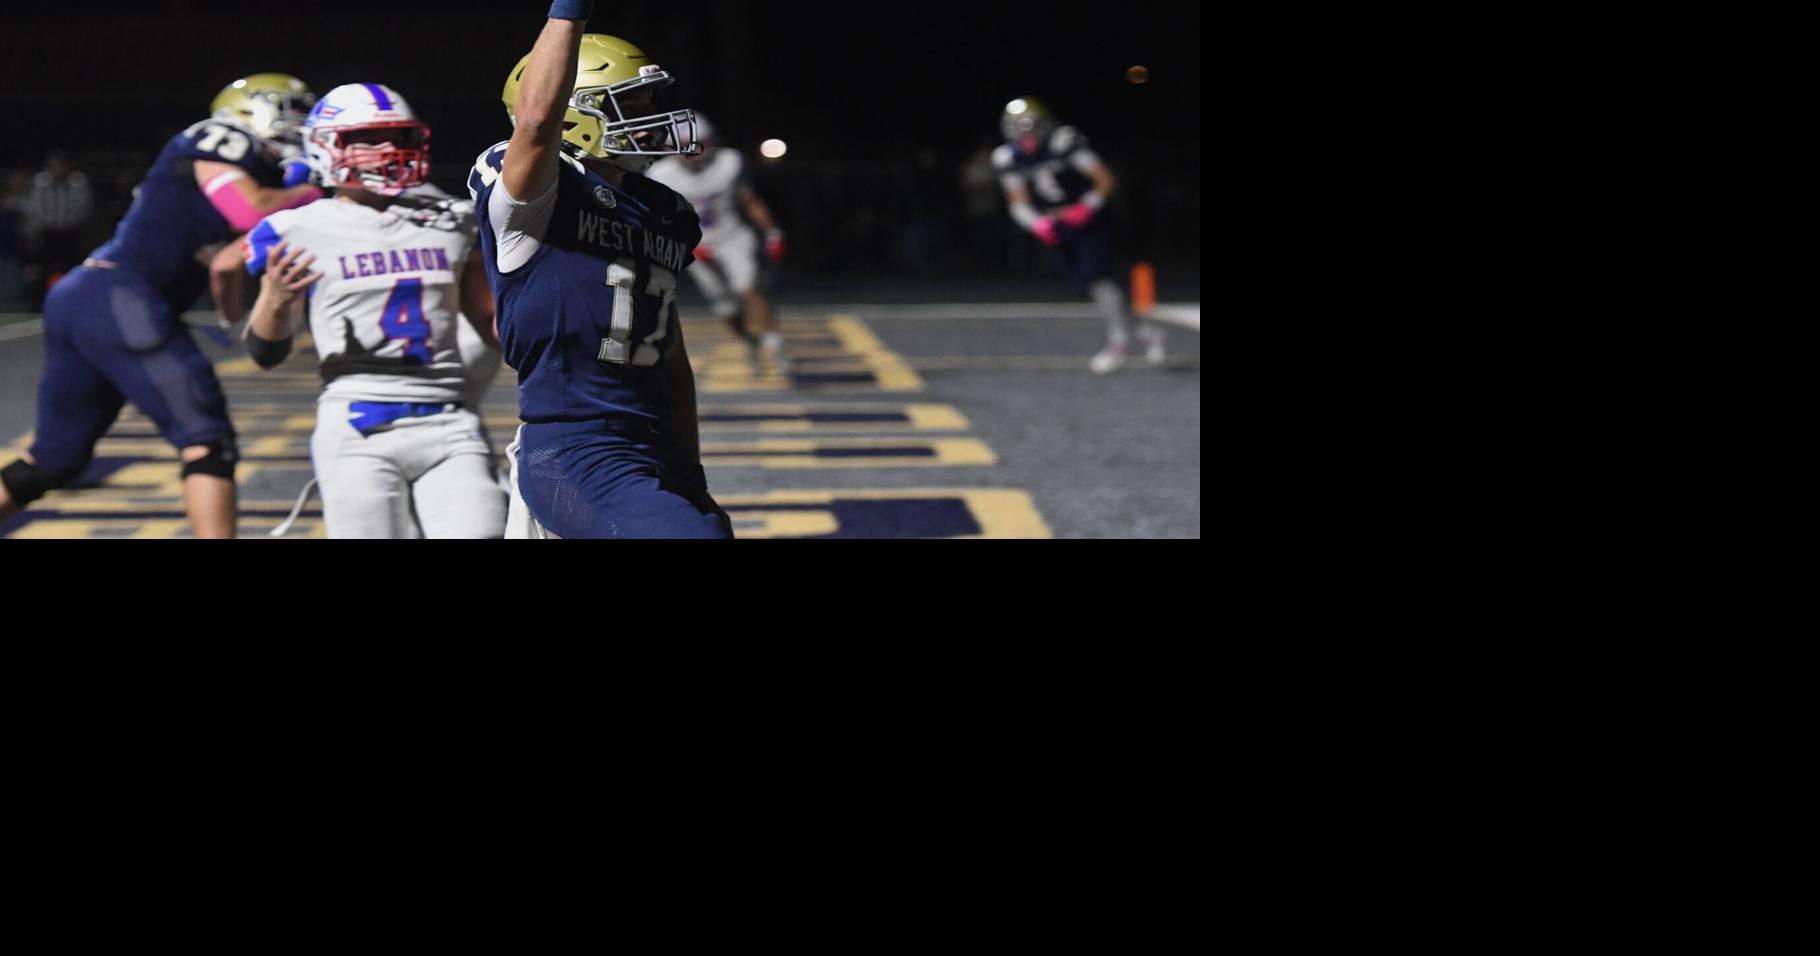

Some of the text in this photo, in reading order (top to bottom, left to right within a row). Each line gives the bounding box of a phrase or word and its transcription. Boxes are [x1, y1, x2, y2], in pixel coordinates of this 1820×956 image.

[338, 247, 451, 280] LEBANON
[577, 209, 688, 272] WEST ALBAN
[378, 277, 433, 365] 4
[598, 258, 678, 366] 17
